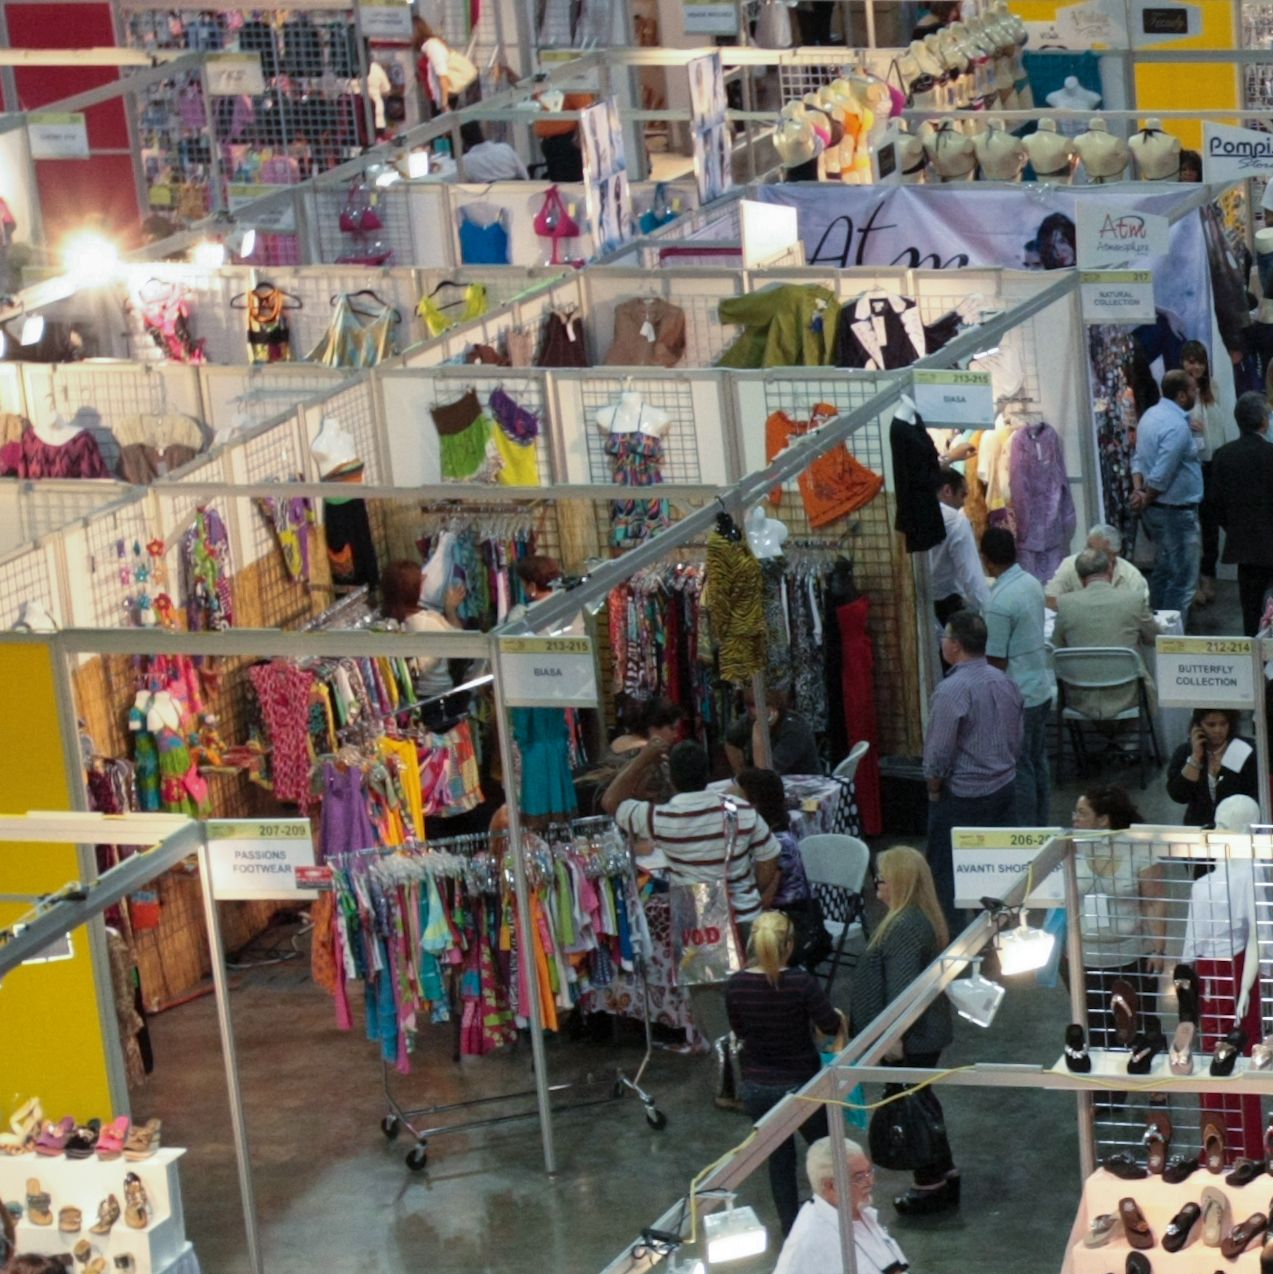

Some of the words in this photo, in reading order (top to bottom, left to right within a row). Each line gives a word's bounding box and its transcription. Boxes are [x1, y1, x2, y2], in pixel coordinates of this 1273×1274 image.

[546, 640, 589, 652] 213-215
[1206, 642, 1251, 652] 212-214
[534, 668, 563, 676] BIASA
[1178, 664, 1235, 674] BUTTERFLY
[1176, 677, 1238, 687] COLLECTION
[259, 825, 306, 836] 207-209
[234, 850, 287, 860] PASSIONS
[232, 864, 292, 874] FOOTWEAR
[956, 863, 995, 873] AVANTI
